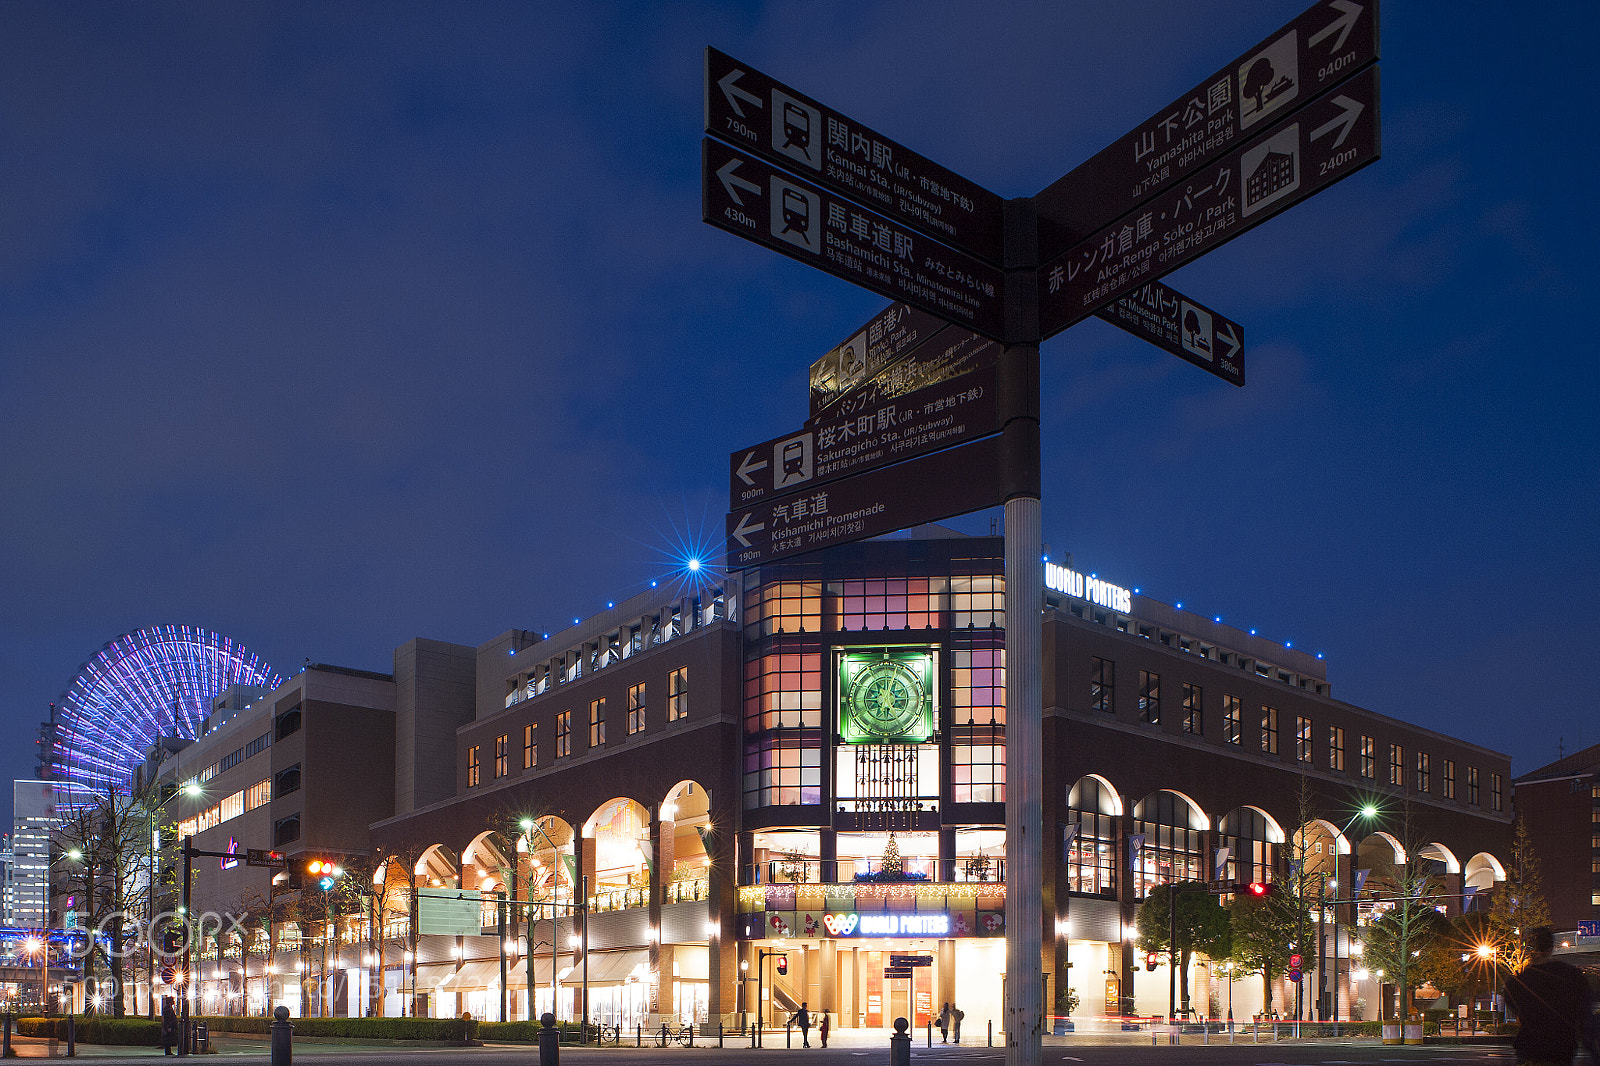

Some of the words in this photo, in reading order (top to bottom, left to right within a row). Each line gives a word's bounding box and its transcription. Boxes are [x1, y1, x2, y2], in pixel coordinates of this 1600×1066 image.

[1317, 51, 1356, 83] 940m
[726, 116, 758, 142] 790m
[1134, 74, 1231, 164] 山下公園
[827, 116, 893, 174] 関内駅
[1147, 126, 1205, 173] Yamashita
[1206, 109, 1235, 137] Park
[1319, 147, 1357, 176] 240m
[827, 148, 867, 178] Kannai
[870, 170, 891, 190] Sta.
[893, 183, 942, 215] (JR/Subway)
[724, 207, 756, 229] 430m
[826, 201, 914, 263] 馬車道駅
[924, 257, 996, 298] みなとみらい線
[1097, 239, 1160, 283] Aka-Renga
[1206, 195, 1236, 221] Park
[826, 231, 890, 269] Bashamichi
[893, 261, 913, 279] Sta.
[916, 273, 963, 301] Minatomirai
[964, 292, 981, 308] Line
[1128, 299, 1161, 324] Museum
[1162, 316, 1179, 333] Park
[817, 404, 897, 450] 桜木町駅
[880, 431, 901, 446] Sta.
[903, 414, 954, 440] (JR/Subway)
[741, 487, 764, 501] 900m
[772, 492, 829, 527] 汽車道
[771, 517, 824, 541] Kishamichi
[826, 502, 885, 526] Promenade
[738, 550, 761, 563] 190m
[1045, 561, 1084, 599] WORLD
[1085, 575, 1132, 615] PORTERS
[860, 915, 899, 934] WORLD
[899, 915, 949, 934] PORTERS
